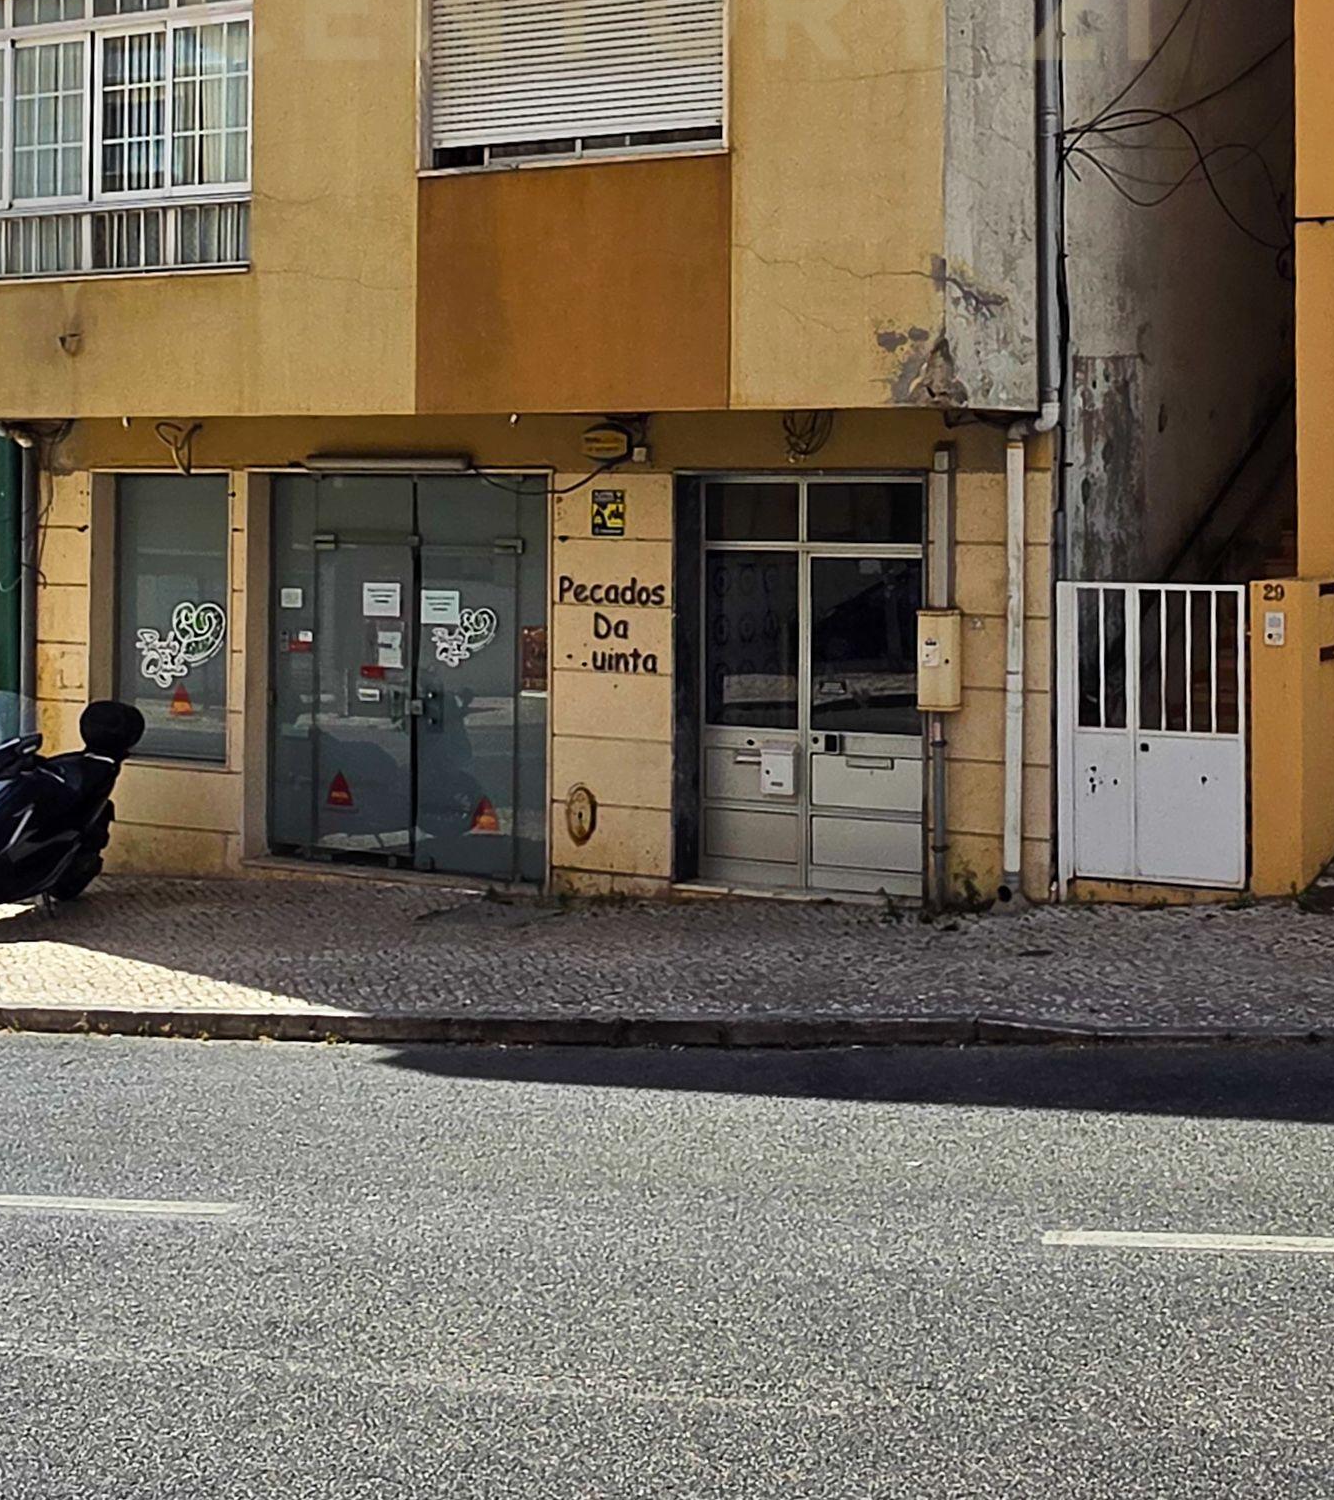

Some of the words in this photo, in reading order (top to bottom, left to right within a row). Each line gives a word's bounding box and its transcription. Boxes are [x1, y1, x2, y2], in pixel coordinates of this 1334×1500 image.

[559, 575, 665, 606] Pecados
[1263, 583, 1285, 602] 29
[593, 611, 629, 640] Da
